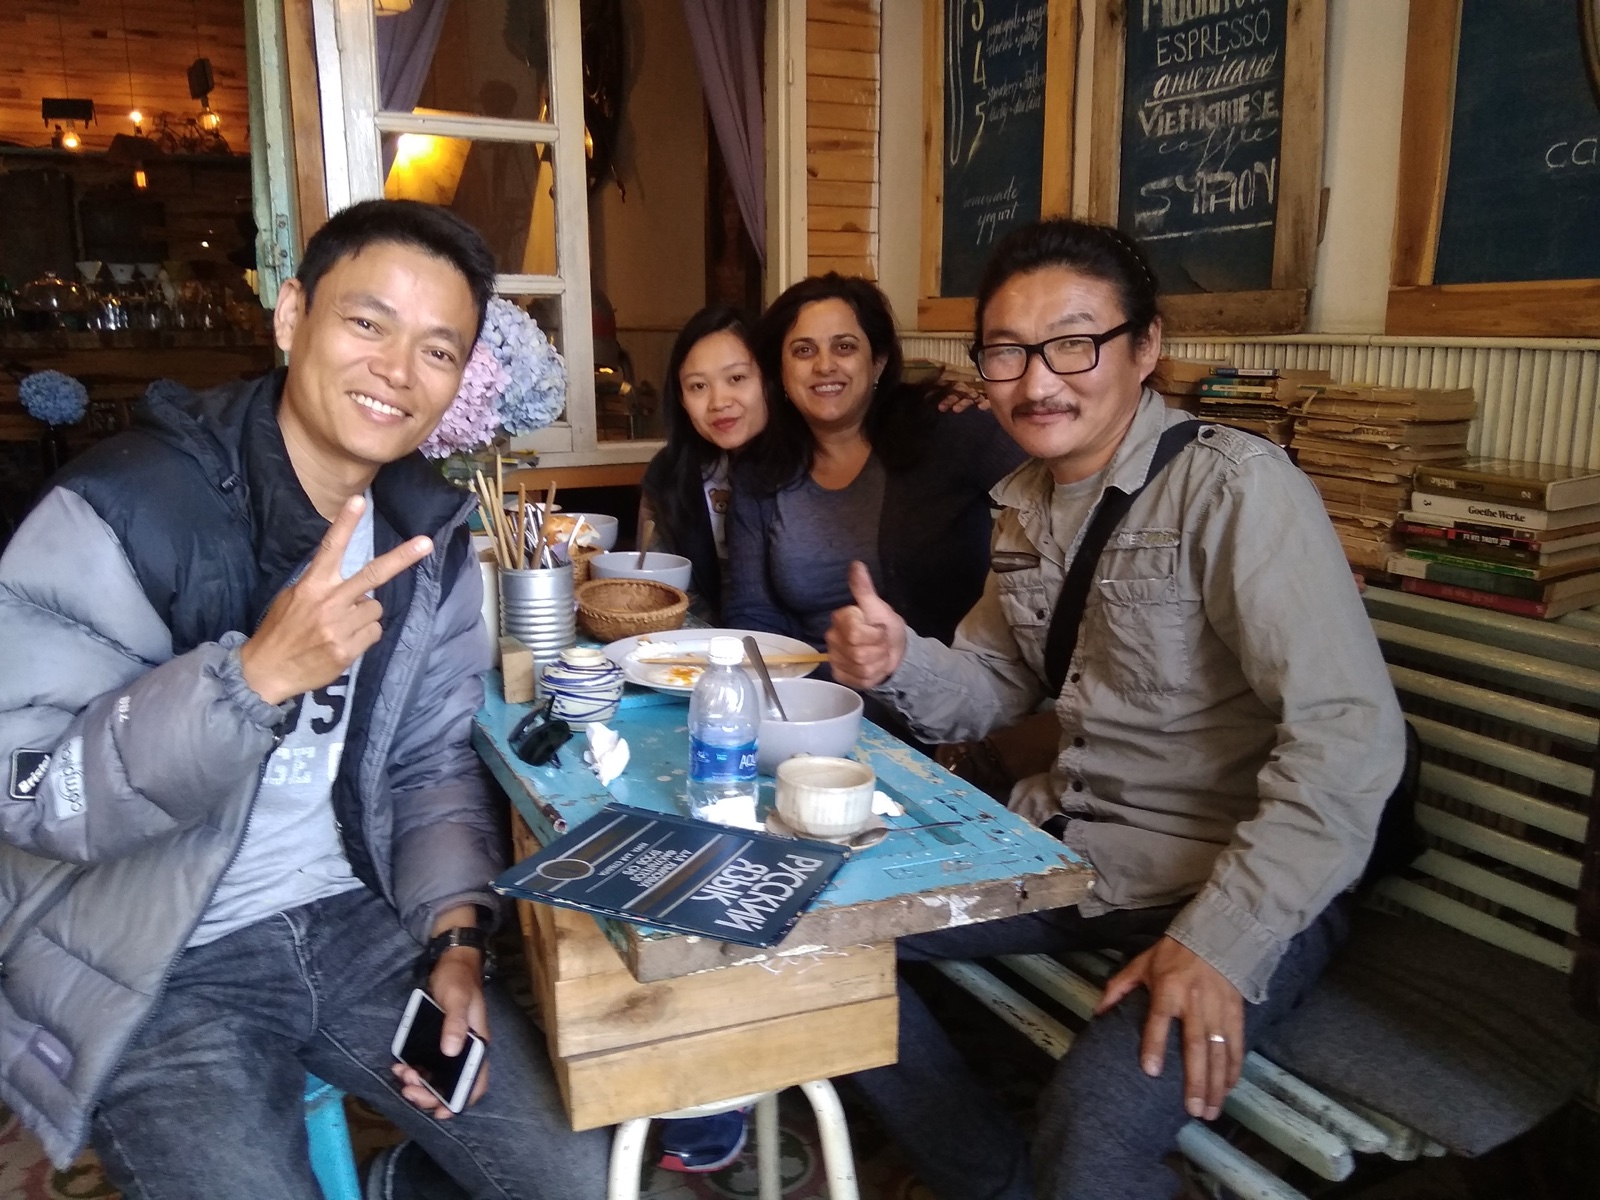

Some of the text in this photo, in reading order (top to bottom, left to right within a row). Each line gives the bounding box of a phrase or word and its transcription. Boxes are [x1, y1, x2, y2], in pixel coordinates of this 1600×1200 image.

[1157, 8, 1270, 67] ESPRESSO
[973, 40, 986, 90] 4
[1153, 46, 1278, 99] americano
[1159, 126, 1277, 173] coffee
[1135, 157, 1276, 231] SYPHON
[1468, 505, 1526, 523] Goethe Werke
[17, 754, 51, 794] Bristol
[690, 857, 771, 907] ЯЗЫК
[714, 854, 824, 932] РУССКИЙ
